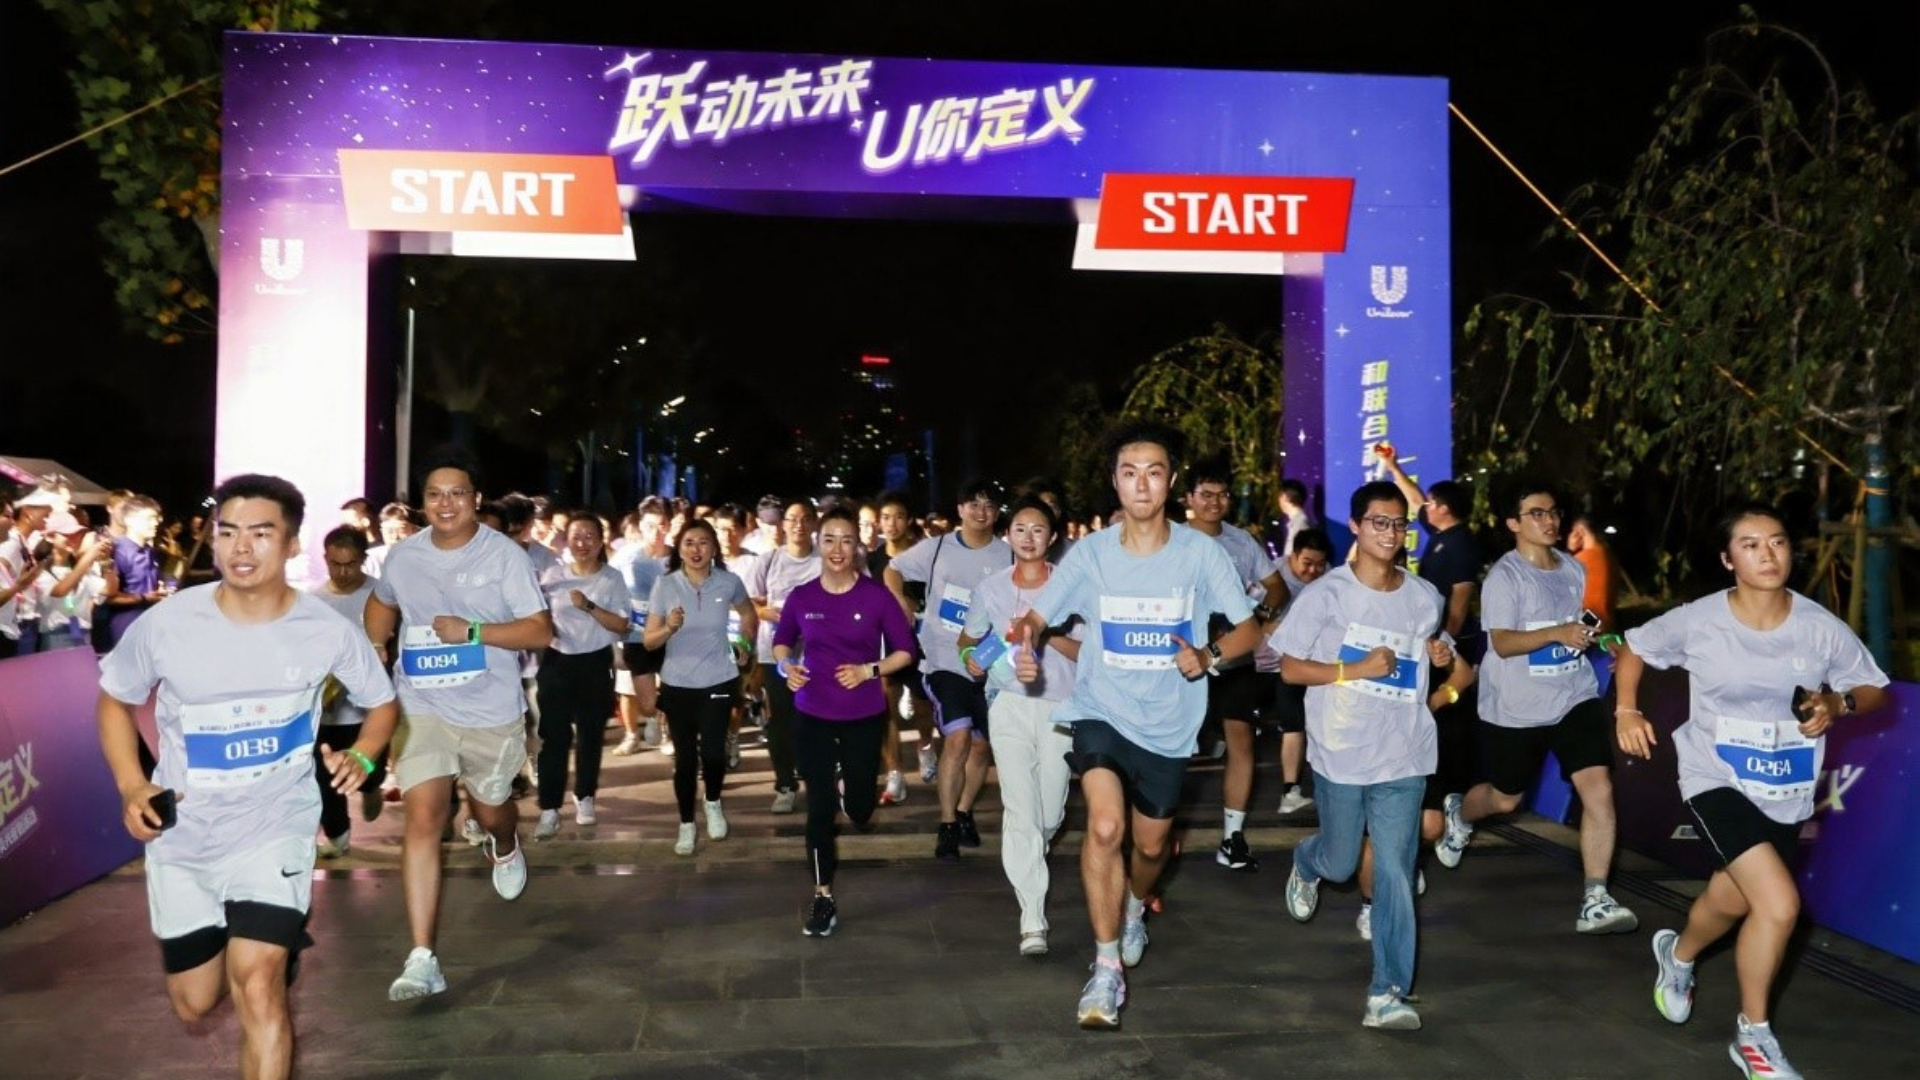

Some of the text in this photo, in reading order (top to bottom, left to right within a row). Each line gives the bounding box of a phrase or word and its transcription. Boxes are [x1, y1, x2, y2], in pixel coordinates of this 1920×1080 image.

[608, 59, 873, 163] 跃动未来
[861, 76, 1094, 170] U你定义
[390, 168, 576, 217] START
[1143, 191, 1308, 236] START
[1125, 631, 1171, 647] 0884
[417, 654, 458, 669] 0094
[225, 736, 279, 760] 0139
[1746, 756, 1792, 776] 0264
